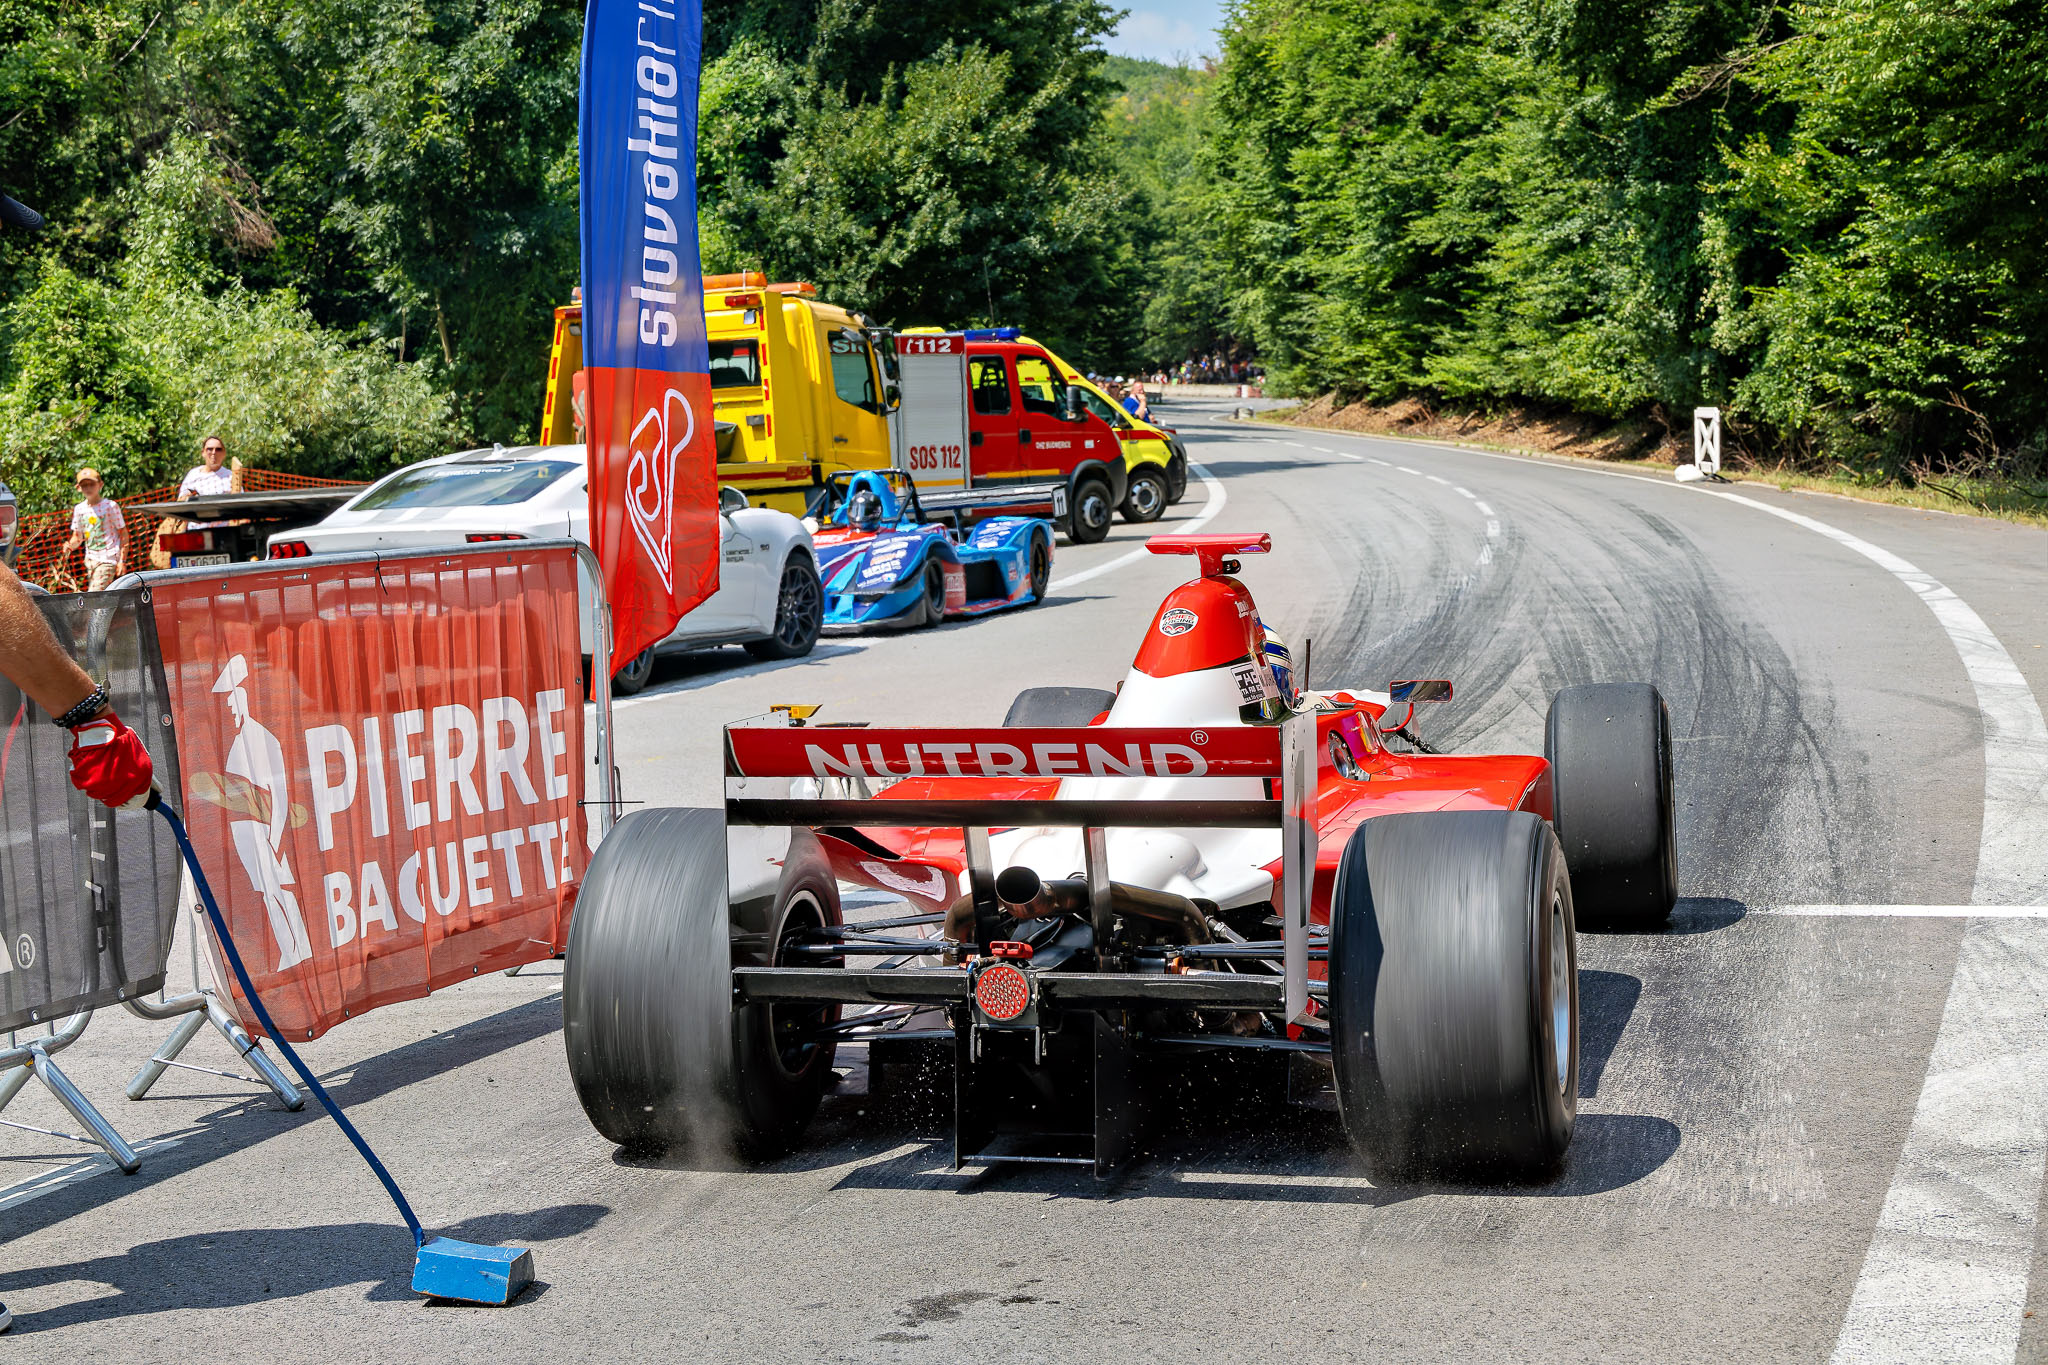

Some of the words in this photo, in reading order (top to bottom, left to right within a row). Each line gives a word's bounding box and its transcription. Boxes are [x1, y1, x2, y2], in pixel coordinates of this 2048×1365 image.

[627, 0, 679, 347] slovakiari
[914, 338, 951, 353] 112
[910, 445, 937, 470] SOS
[940, 445, 961, 469] 112
[304, 688, 568, 852] PIERRE
[804, 743, 1208, 777] NUTREND
